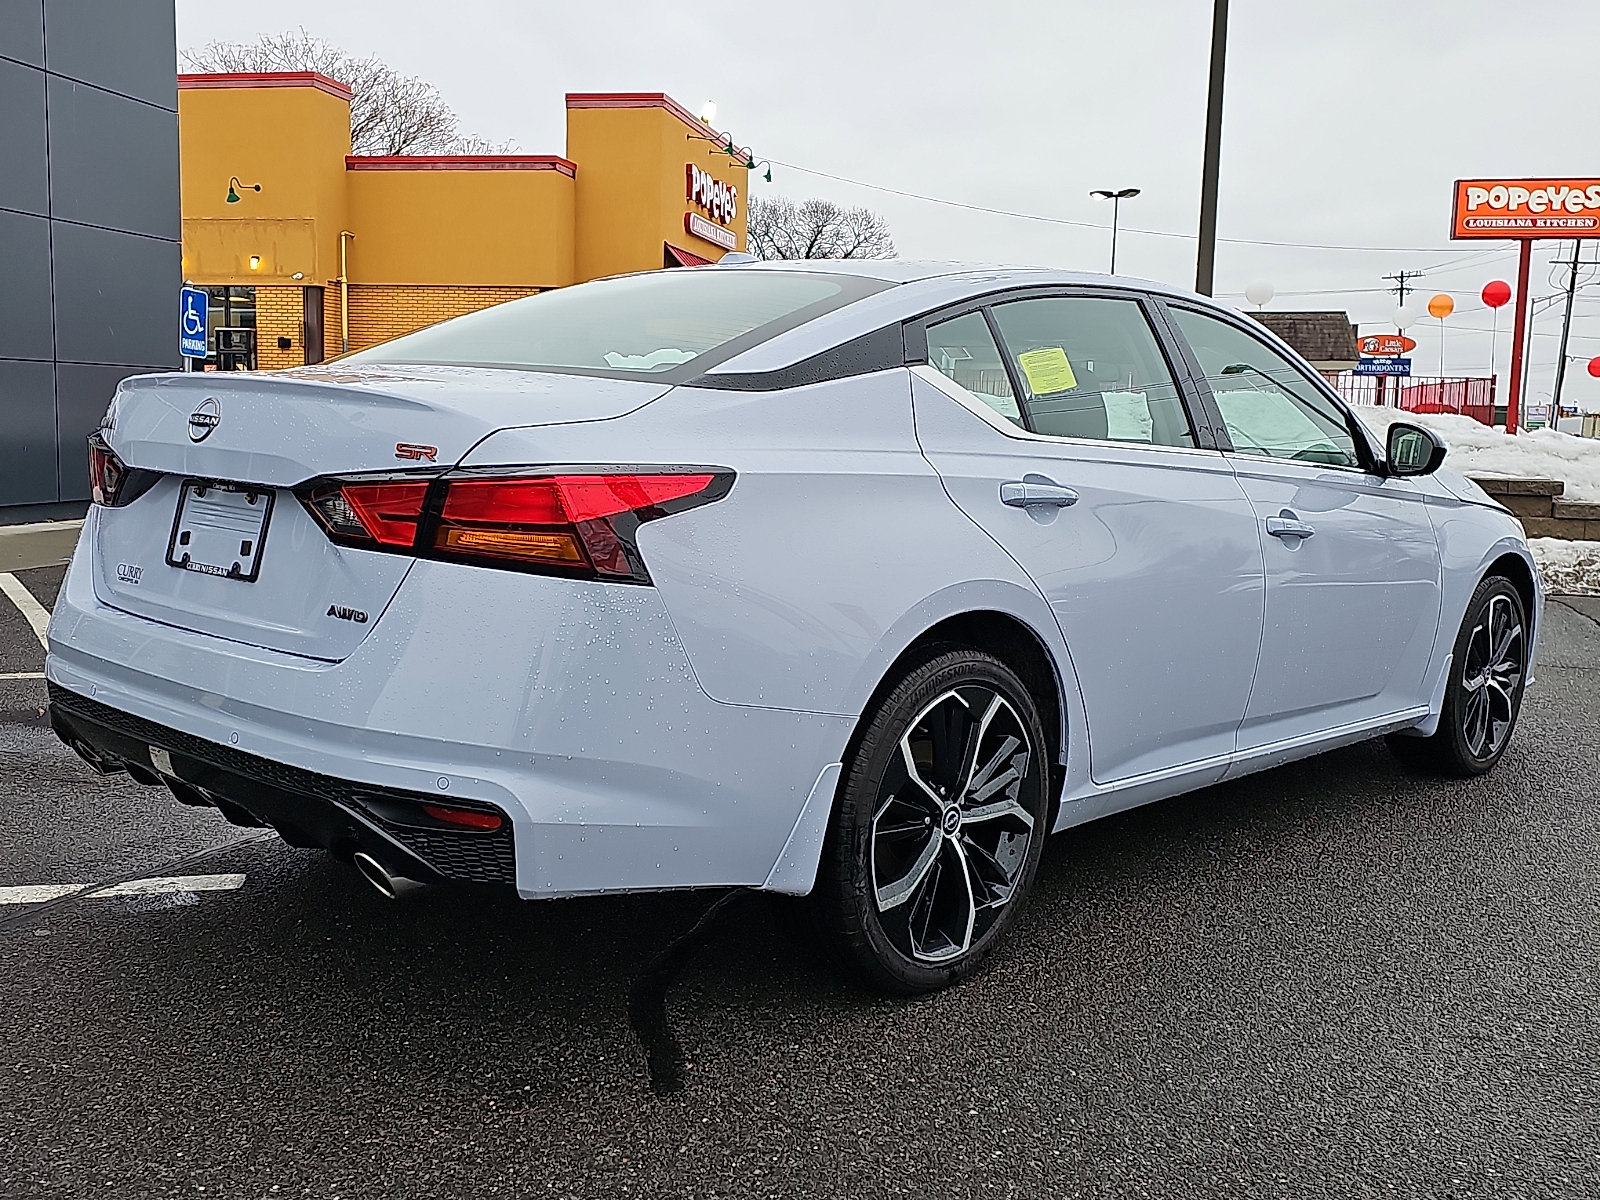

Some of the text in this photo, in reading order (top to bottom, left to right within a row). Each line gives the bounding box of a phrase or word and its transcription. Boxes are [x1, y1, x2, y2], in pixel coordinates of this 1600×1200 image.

[1468, 218, 1595, 228] LOUISIANA KITCHEN
[182, 337, 206, 352] PARKING
[394, 442, 438, 463] SR
[116, 563, 144, 580] CURRY
[200, 564, 229, 577] NISSAN
[326, 604, 369, 624] AWD
